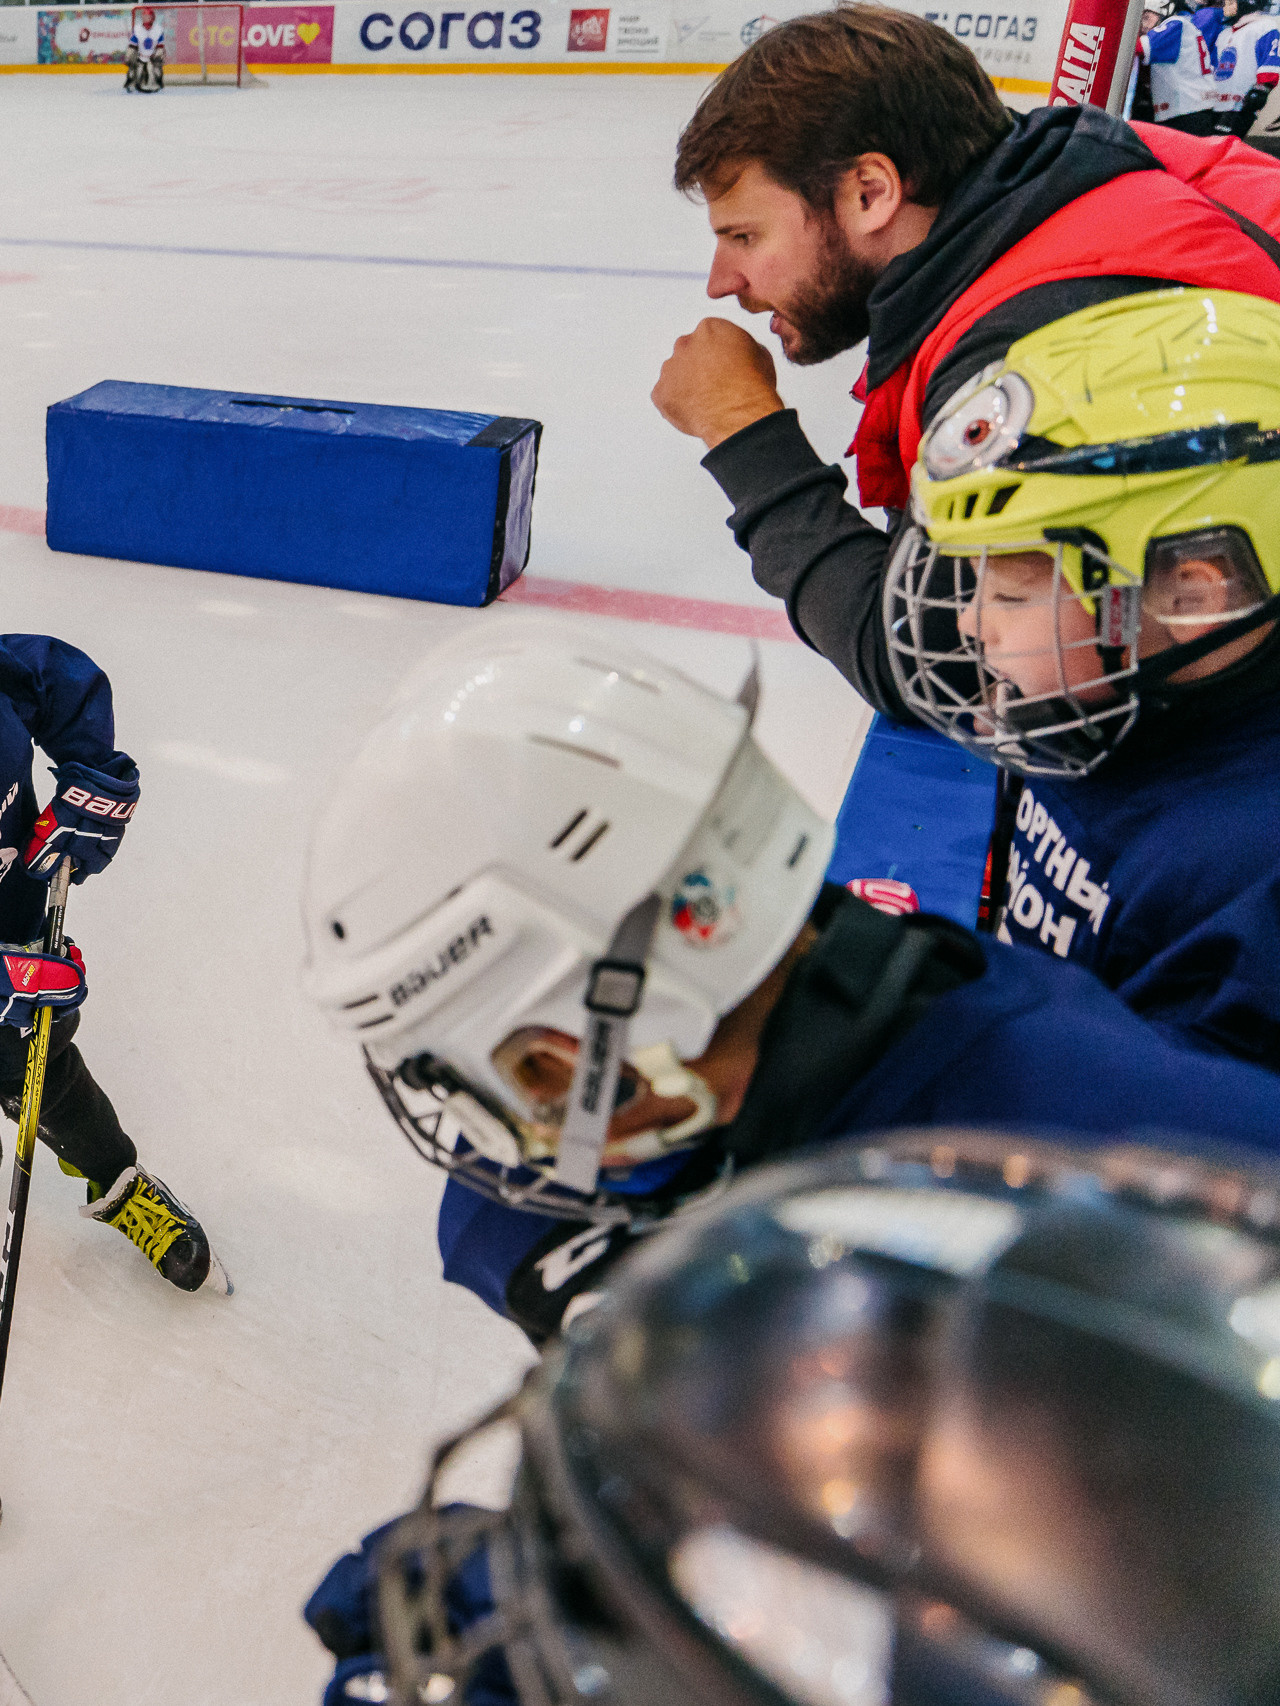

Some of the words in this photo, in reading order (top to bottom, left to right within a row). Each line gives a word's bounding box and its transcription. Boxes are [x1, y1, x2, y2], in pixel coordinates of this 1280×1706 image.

[241, 24, 296, 48] LOVE
[954, 12, 1037, 42] СОГАЗ
[61, 784, 136, 819] BAU
[389, 913, 494, 1008] BAUER
